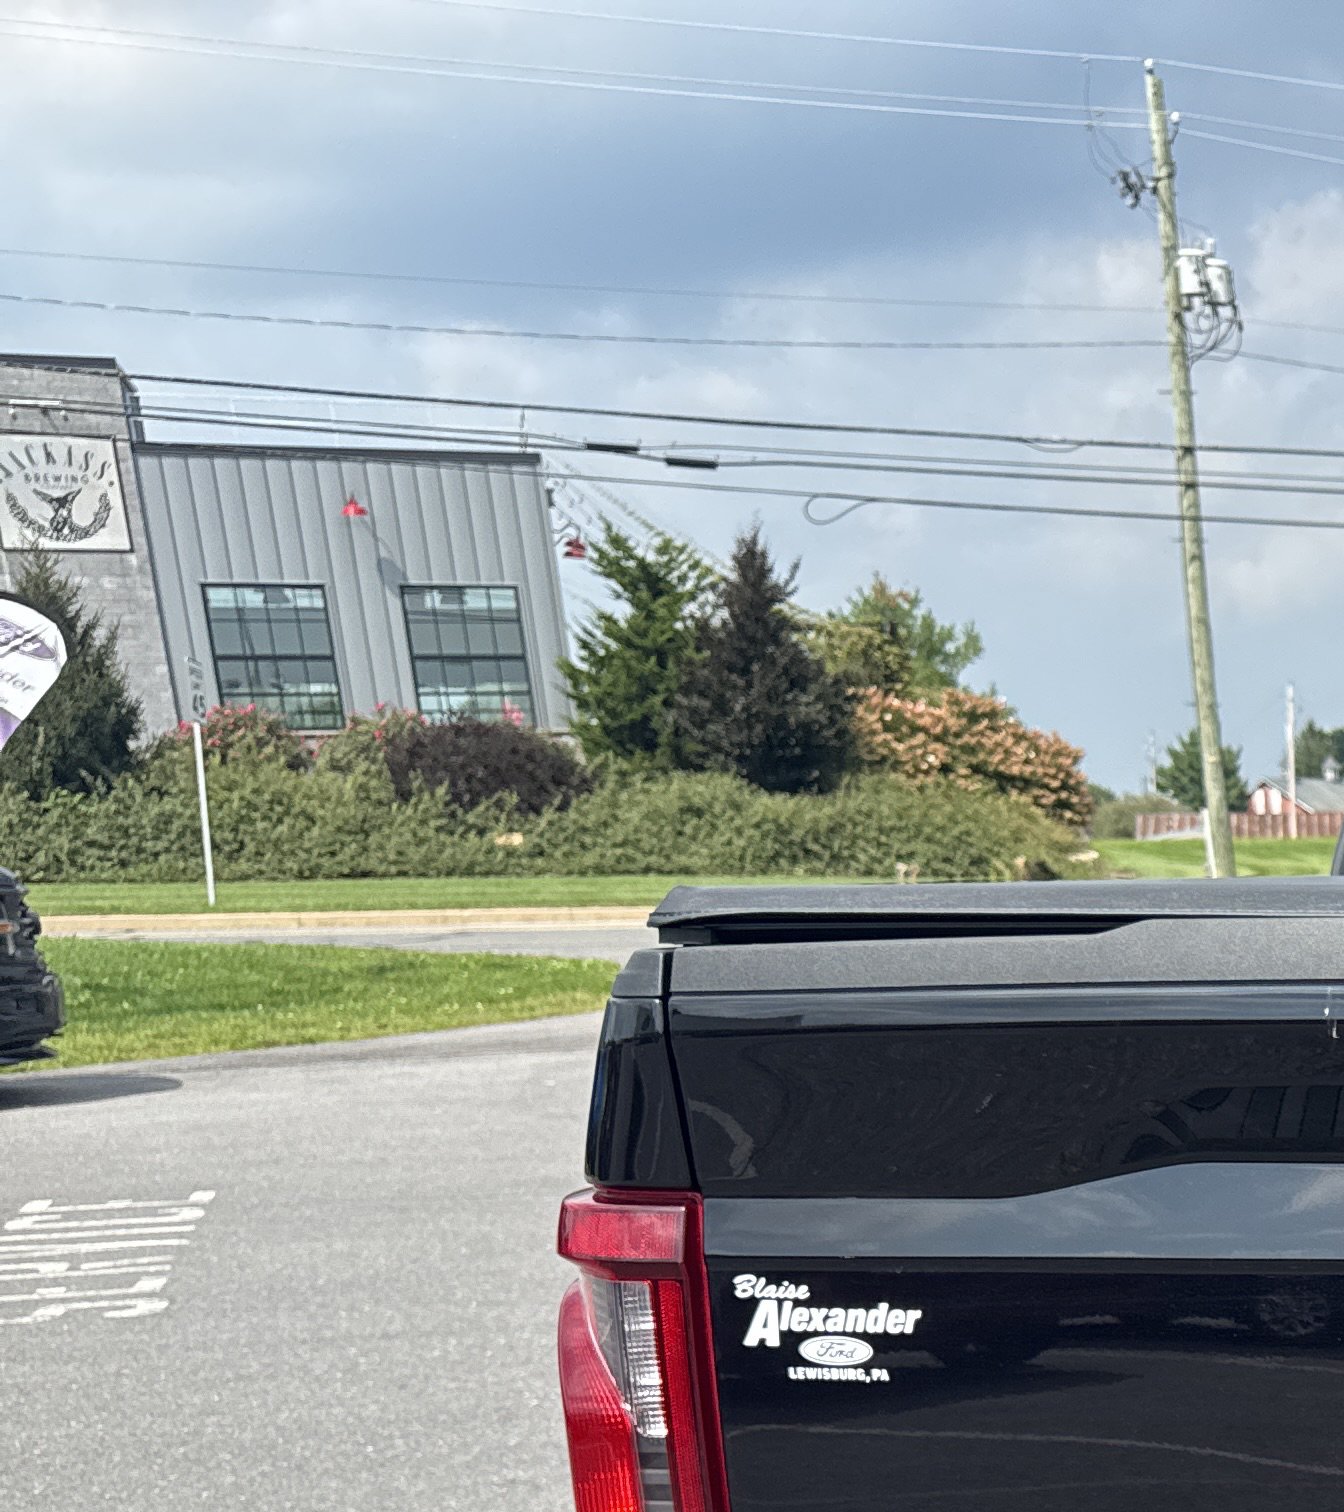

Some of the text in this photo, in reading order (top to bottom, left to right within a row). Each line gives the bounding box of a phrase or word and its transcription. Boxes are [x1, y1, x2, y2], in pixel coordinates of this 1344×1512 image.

[732, 1273, 811, 1300] Blaise
[742, 1299, 923, 1348] Alexander
[816, 1341, 857, 1360] Ford
